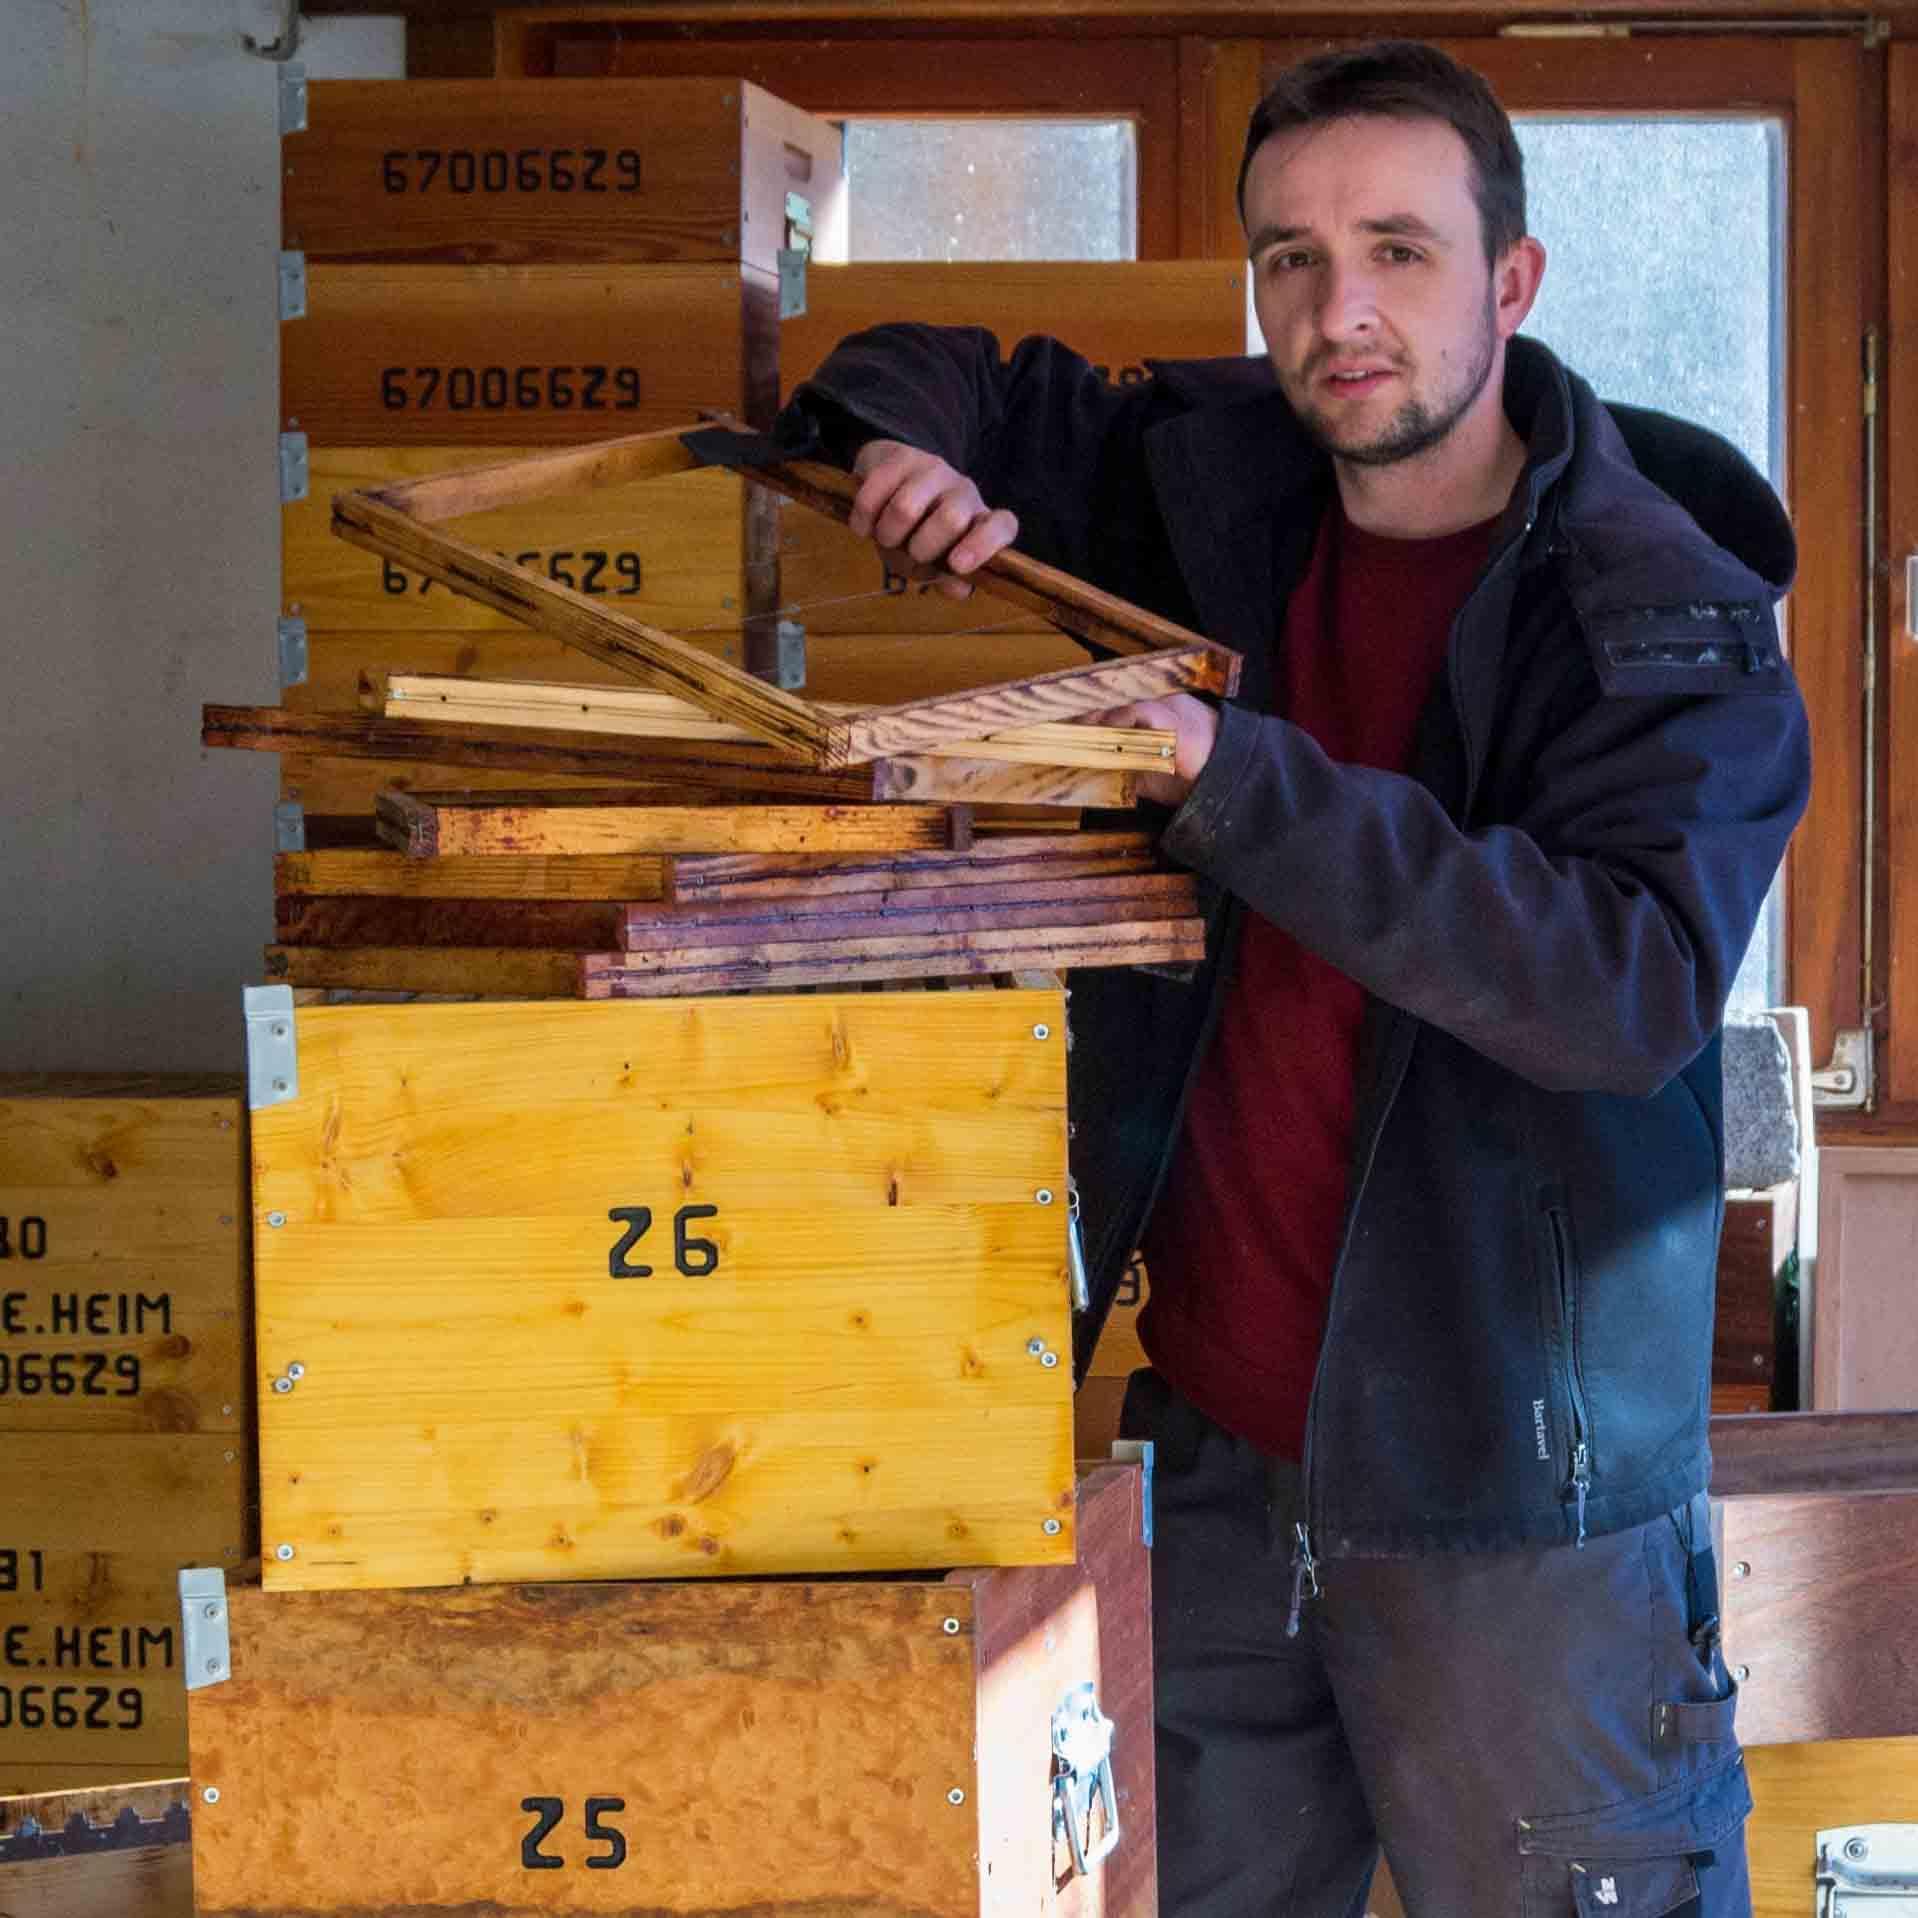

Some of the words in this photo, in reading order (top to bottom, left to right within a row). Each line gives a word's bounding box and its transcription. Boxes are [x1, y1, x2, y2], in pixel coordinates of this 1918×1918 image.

[382, 149, 641, 193] 67006629
[381, 366, 641, 411] 67006629
[608, 1204, 719, 1279] 26
[2, 1292, 172, 1335] E.HEIM
[4, 1625, 174, 1669] E.HEIM
[520, 1796, 627, 1870] 25
